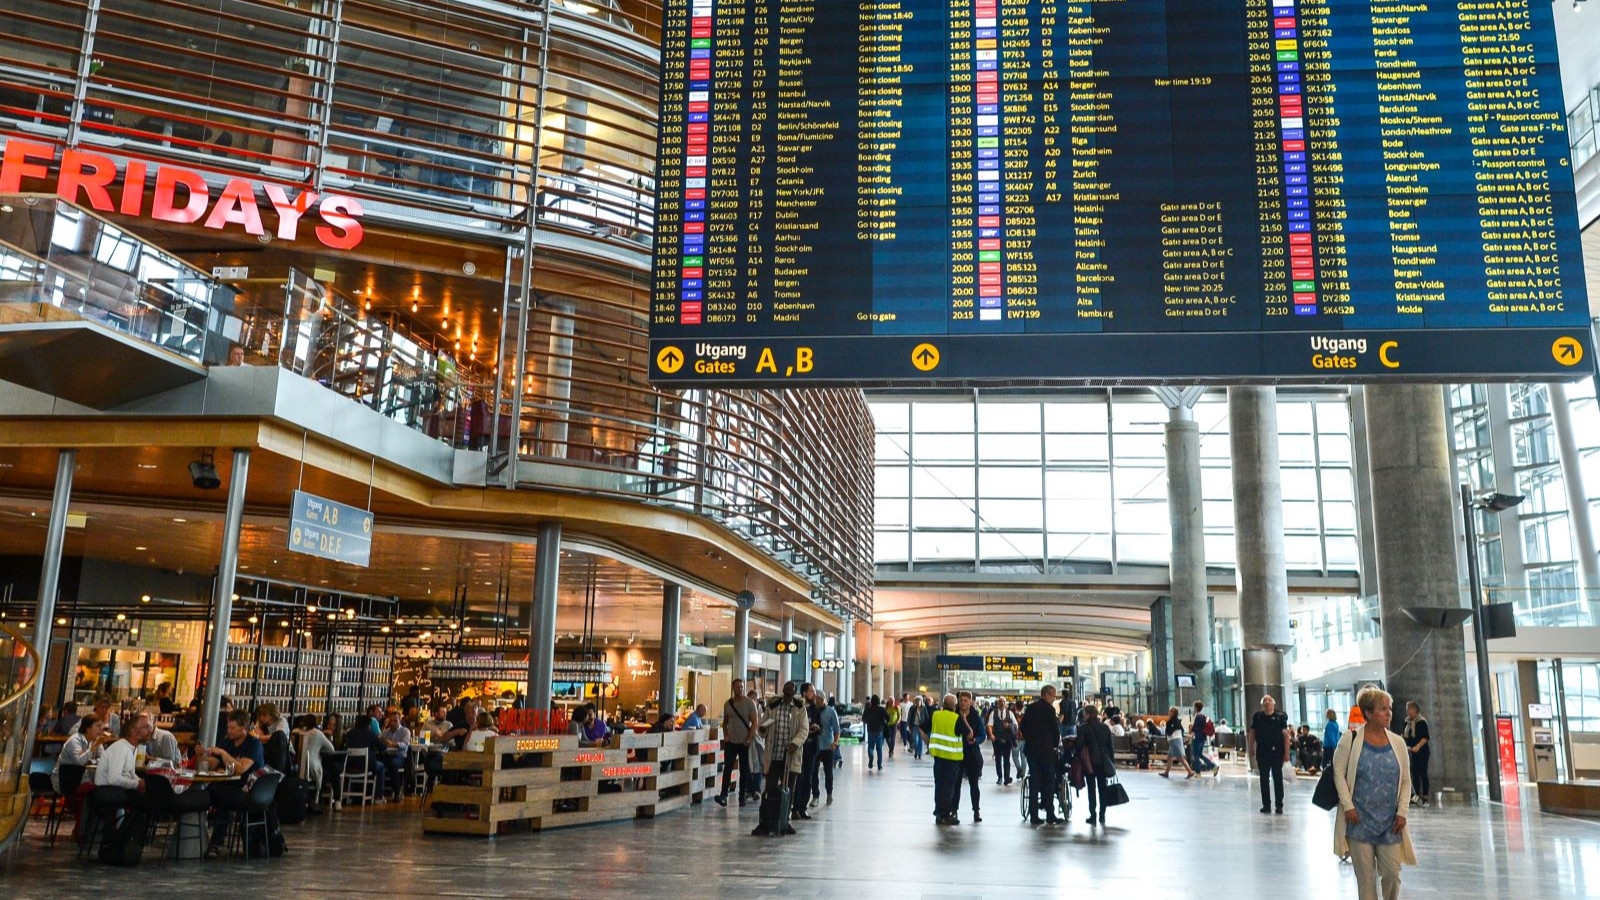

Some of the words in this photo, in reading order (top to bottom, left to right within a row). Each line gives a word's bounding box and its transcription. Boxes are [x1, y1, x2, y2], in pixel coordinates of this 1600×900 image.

[1072, 137, 1088, 146] Riga
[1, 139, 364, 249] FRIDAYS
[953, 253, 973, 261] 20:00
[695, 343, 746, 359] Utgang
[755, 348, 777, 373] A
[1310, 336, 1367, 353] Utgang
[1378, 340, 1400, 368] C
[694, 360, 736, 374] Gates
[1312, 354, 1356, 368] Gates
[307, 498, 322, 512] Utgang
[641, 659, 654, 670] my
[630, 669, 656, 682] guest
[516, 740, 534, 750] FOOD
[535, 739, 560, 750] GARAGE
